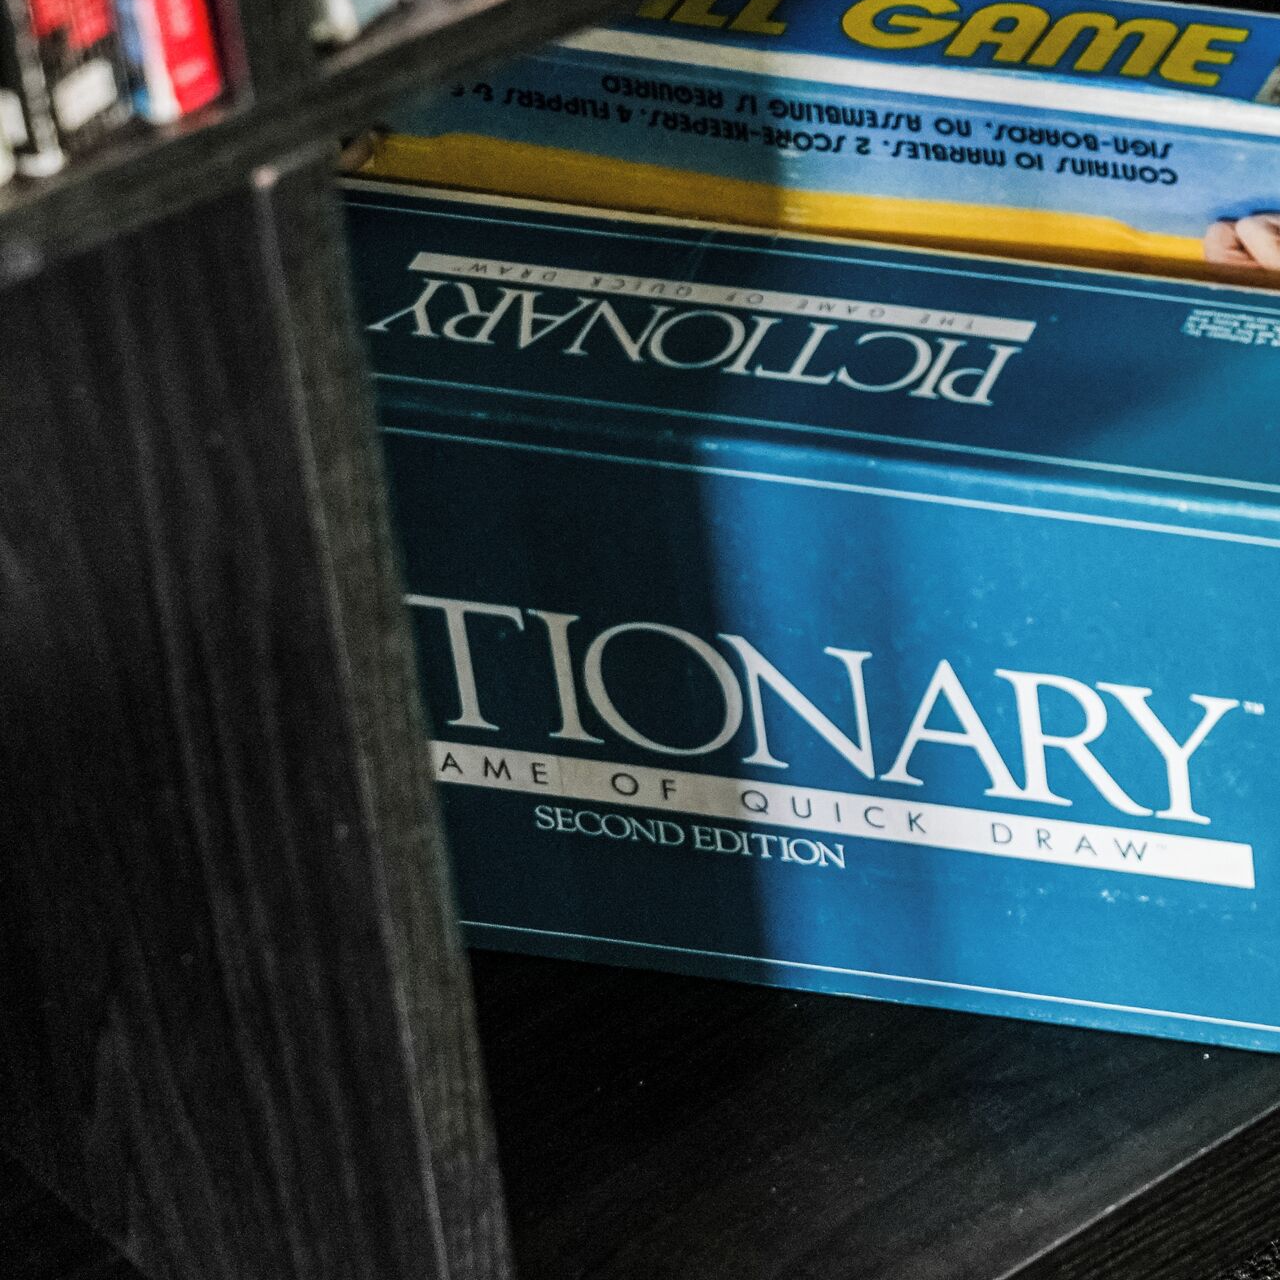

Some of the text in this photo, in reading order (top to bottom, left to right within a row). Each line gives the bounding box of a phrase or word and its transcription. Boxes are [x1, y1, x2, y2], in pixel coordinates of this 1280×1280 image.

[500, 86, 612, 119] FLIPPERS
[600, 73, 725, 111] REQUIRED
[729, 93, 760, 116] IS
[767, 99, 923, 135] ASSEMBLING
[931, 114, 972, 138] NO
[852, 135, 872, 154] 2
[881, 138, 1008, 171] MARBLES.
[1014, 150, 1046, 174] 10
[1053, 154, 1179, 186] CONTAINS
[588, 274, 695, 301] QUICK
[796, 297, 887, 321] GAME
[916, 311, 976, 332] THE
[367, 277, 1025, 407] PICTIONARY
[611, 772, 678, 802] OF
[741, 788, 930, 835] QUICK
[533, 803, 847, 872] SECOND EDITION
